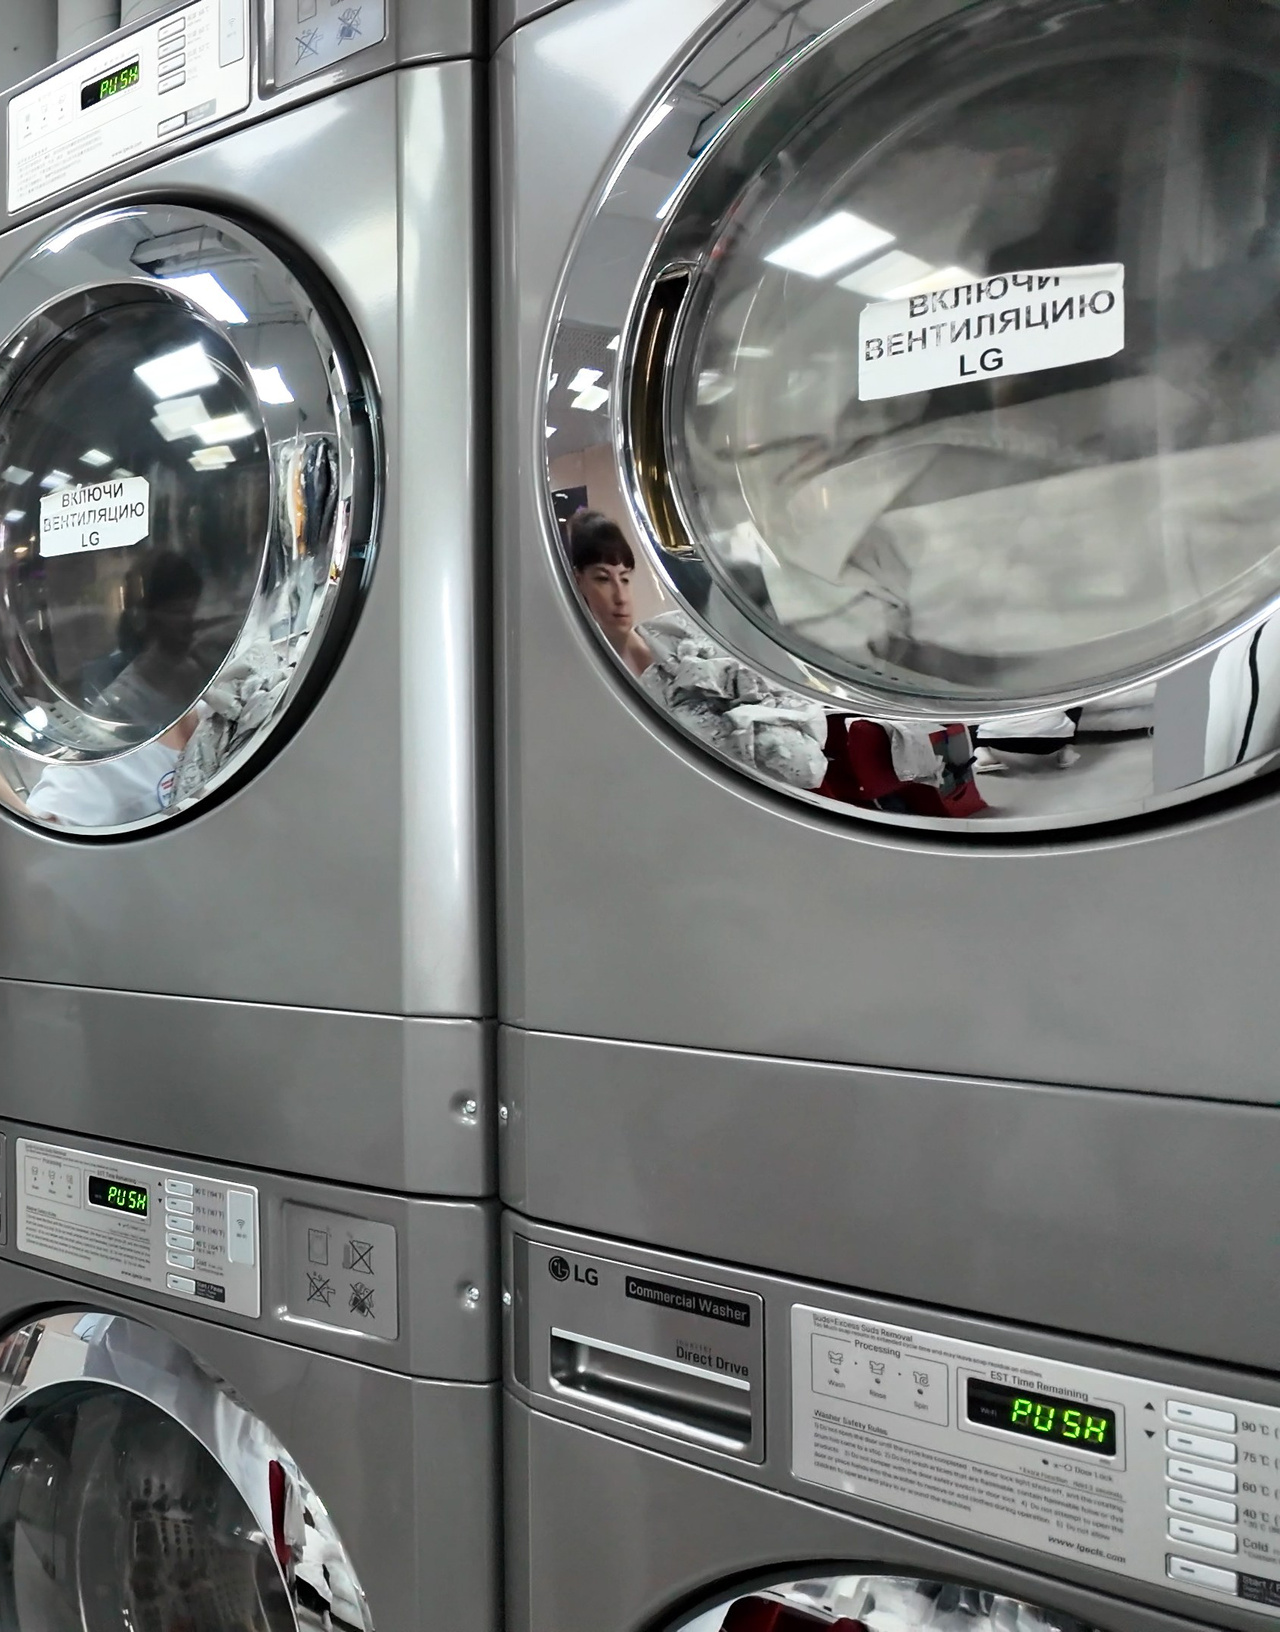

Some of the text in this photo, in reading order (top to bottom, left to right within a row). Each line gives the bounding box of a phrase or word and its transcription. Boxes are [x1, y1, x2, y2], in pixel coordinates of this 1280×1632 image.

[100, 65, 138, 99] PUSH
[909, 274, 1059, 318] ВКЛЮЧИ
[865, 289, 1115, 361] ВЕНТИЛЯЦИЮ
[960, 348, 1003, 376] LG
[62, 483, 124, 507] ВКЛЮЧИ
[43, 502, 145, 532] ВЕНТИЛЯЦИЮ
[81, 531, 100, 547] LG
[108, 1186, 146, 1210] PUSH
[574, 1265, 598, 1286] LG
[629, 1281, 747, 1321] Commercial Washer
[880, 1328, 912, 1342] Removal
[854, 1339, 901, 1358] Processing
[676, 1346, 713, 1367] Direct
[716, 1357, 749, 1376] Drive
[1011, 1375, 1035, 1389] Time
[1036, 1381, 1089, 1401] Remaining
[814, 1409, 888, 1436] Washer Safety Rules
[1011, 1398, 1106, 1443] PUSH
[1241, 1421, 1257, 1433] 90
[1243, 1451, 1257, 1463] 75
[1242, 1482, 1257, 1494] 60
[1243, 1509, 1257, 1520] 40
[1243, 1538, 1269, 1553] Cold
